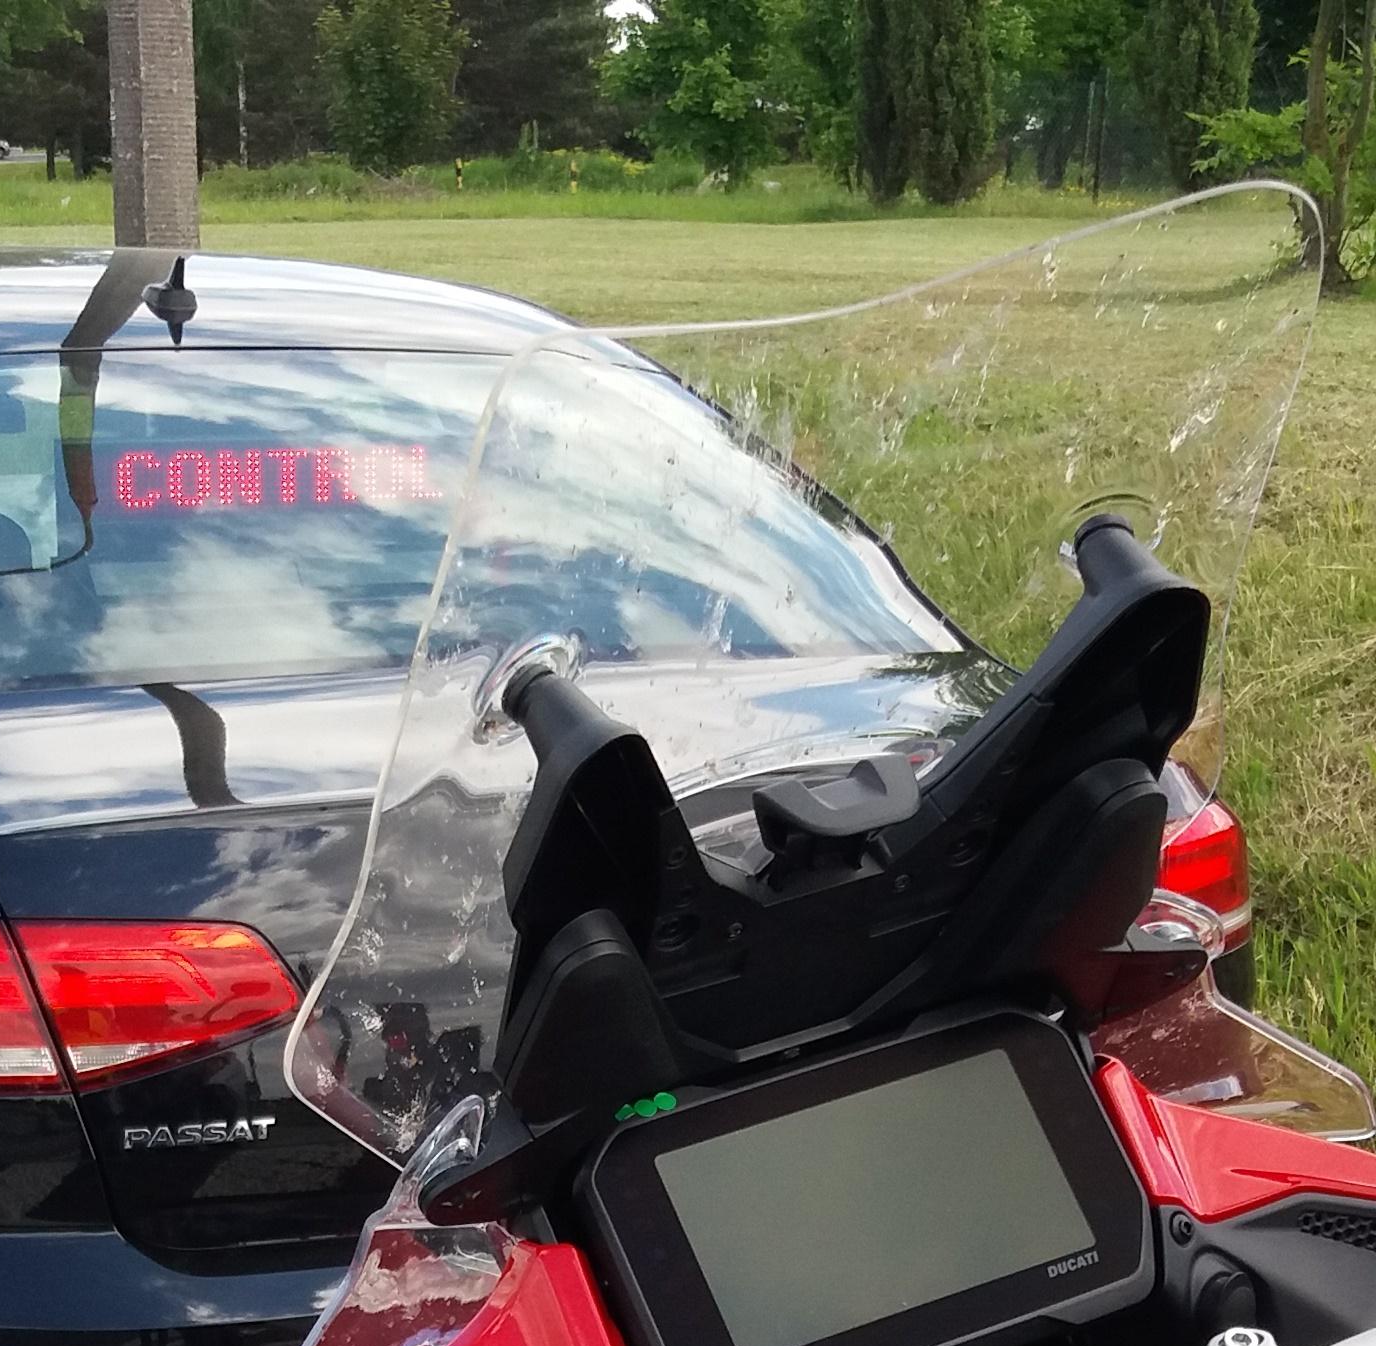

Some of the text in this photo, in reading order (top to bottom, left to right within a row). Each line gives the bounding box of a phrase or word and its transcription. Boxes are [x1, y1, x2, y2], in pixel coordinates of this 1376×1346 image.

[118, 446, 444, 509] CONTROL
[124, 1117, 276, 1150] PASSAT
[1047, 1250, 1100, 1279] DUCATI
